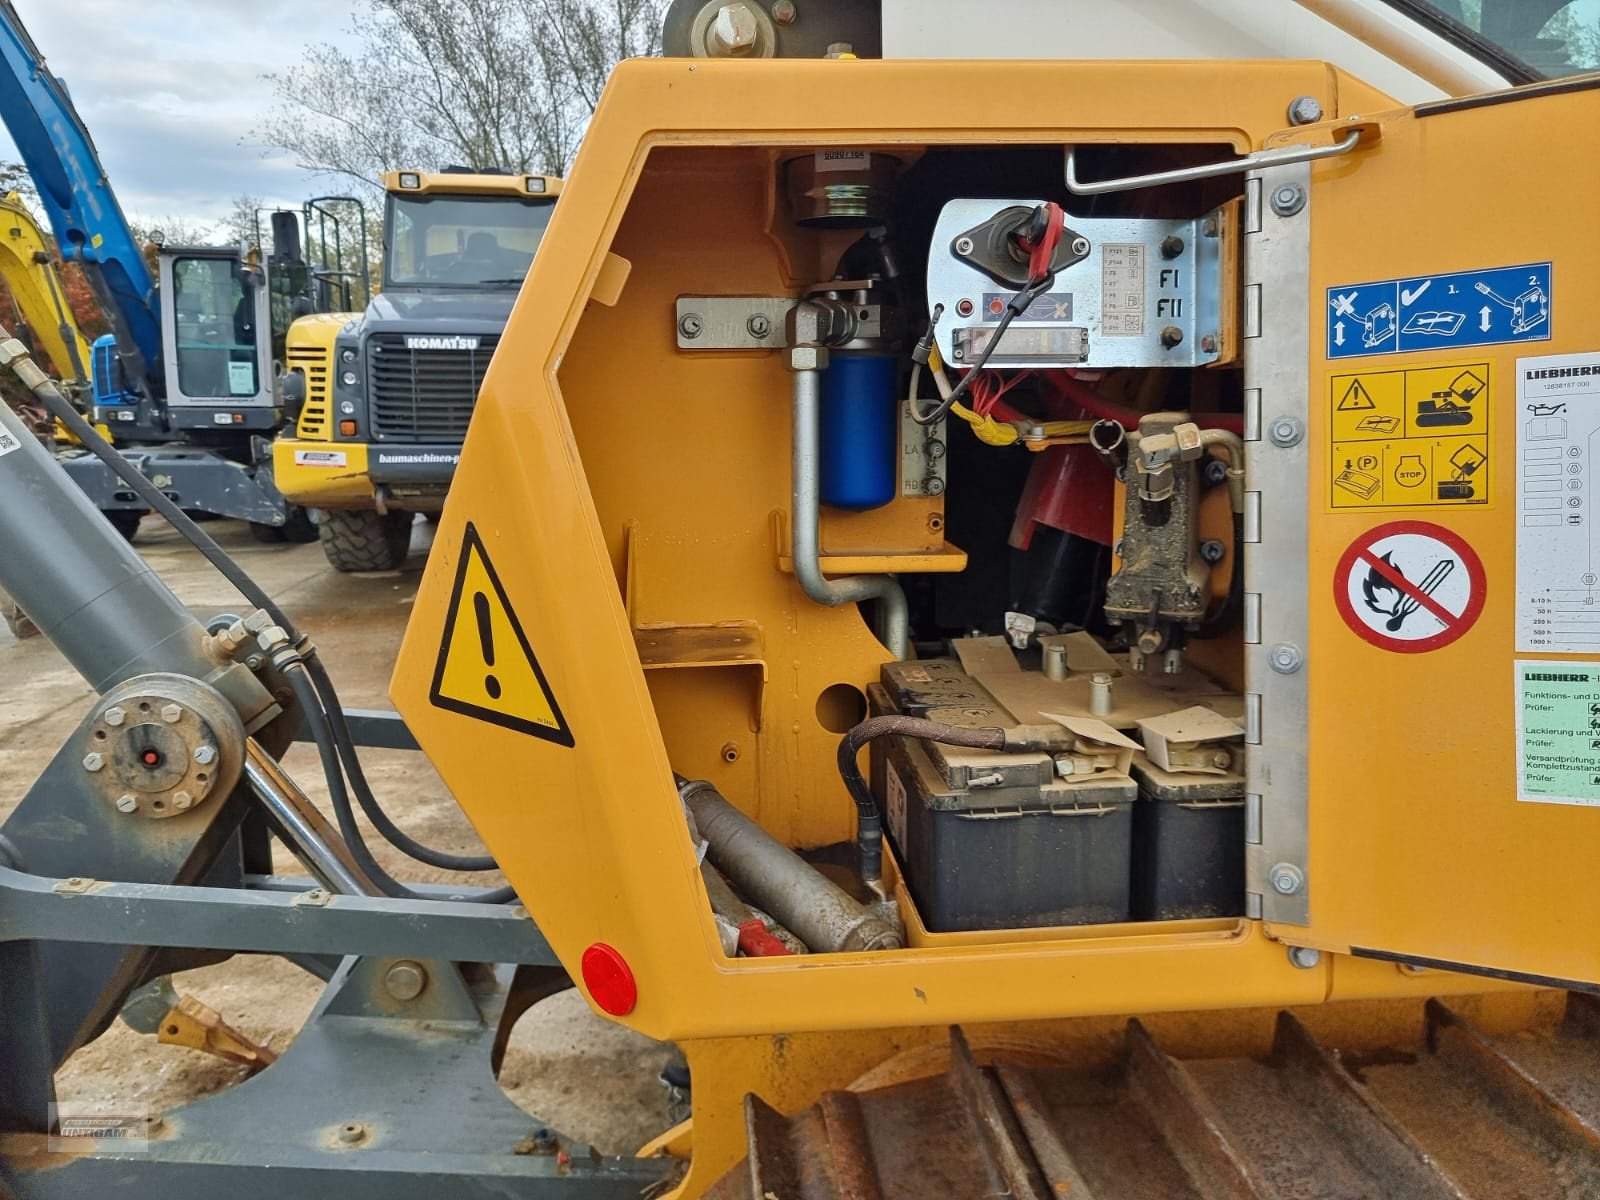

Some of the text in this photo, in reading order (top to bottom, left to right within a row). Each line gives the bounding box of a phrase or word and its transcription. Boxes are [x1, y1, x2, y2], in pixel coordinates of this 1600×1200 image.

[1159, 269, 1179, 289] FI
[1529, 275, 1541, 286] 2.
[1448, 284, 1459, 295] 1.
[1157, 298, 1182, 318] FII
[407, 336, 478, 350] KOMATSU
[1526, 366, 1600, 380] LIEBHERR
[1400, 471, 1421, 479] STOP
[1525, 673, 1590, 683] LIEBHERR
[1525, 691, 1571, 700] Funktions-
[1525, 703, 1554, 712] Prüfer:
[1525, 727, 1574, 737] Lackierung
[1576, 729, 1593, 737] und
[1526, 739, 1555, 747] Prüfer:
[1526, 754, 1595, 766] Versandprüfung
[1526, 773, 1556, 782] Prüfer:
